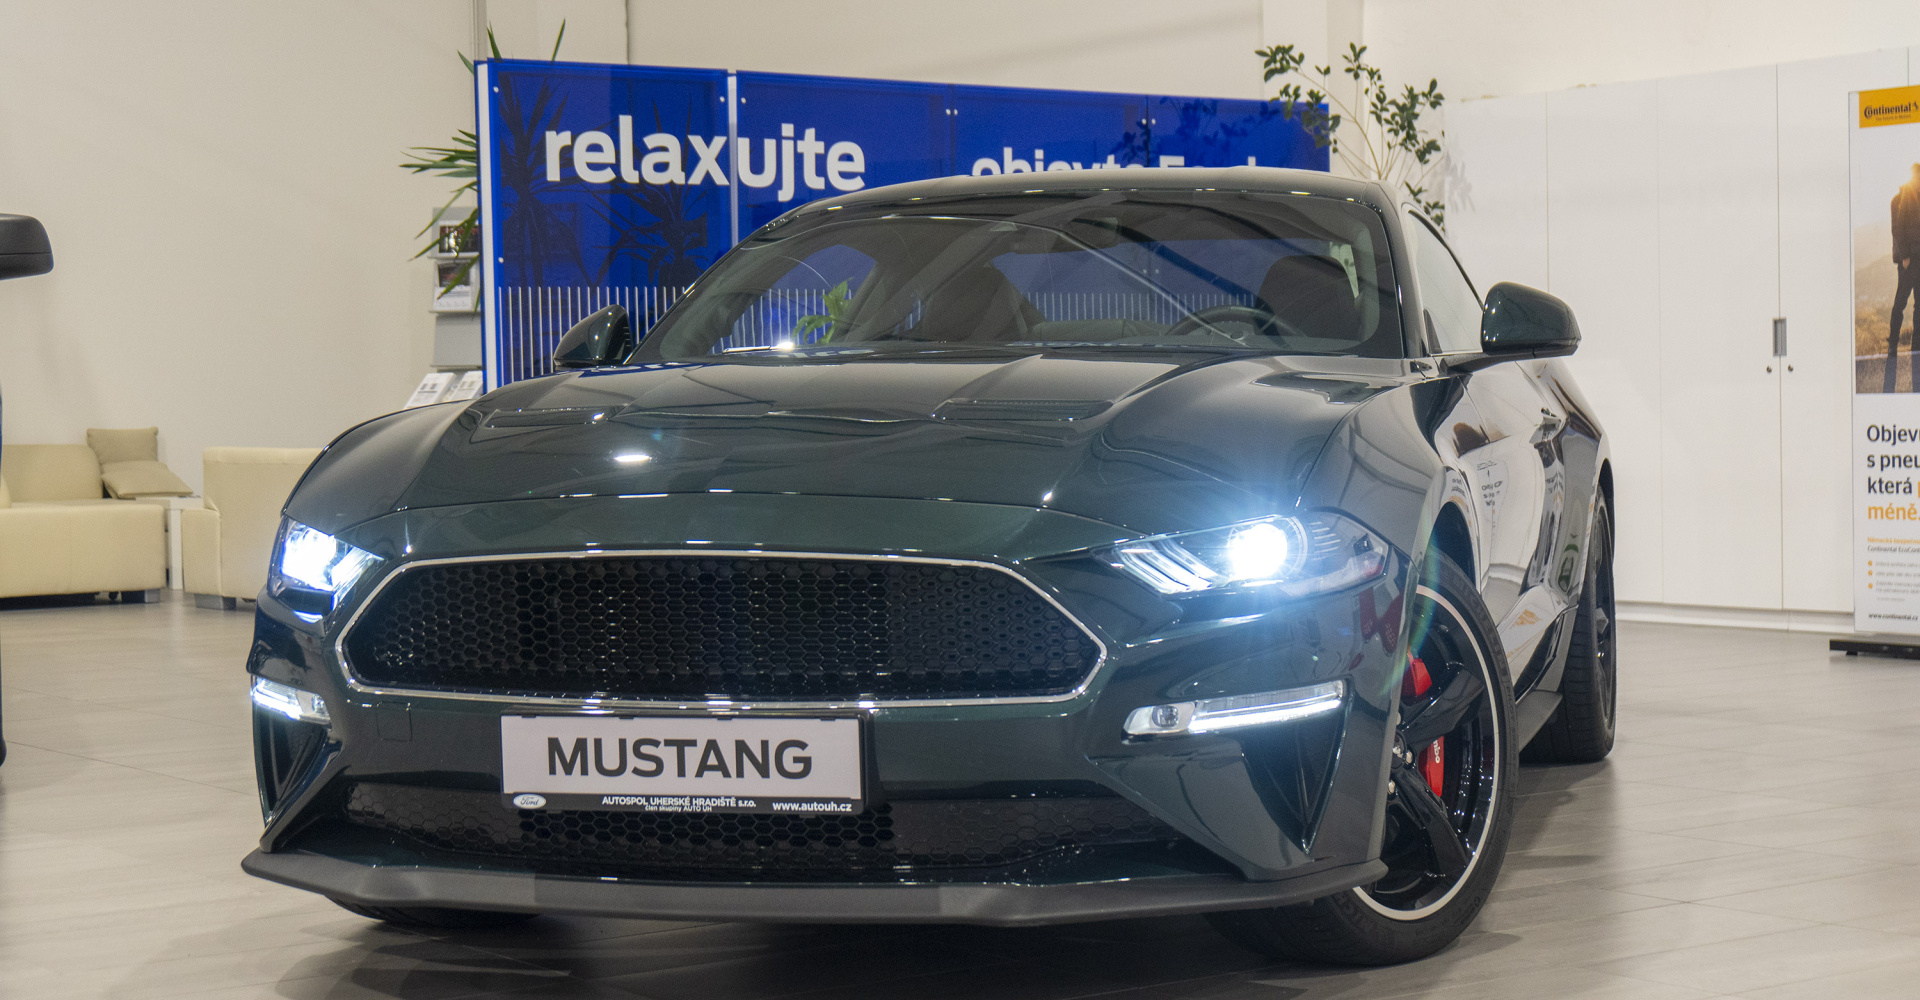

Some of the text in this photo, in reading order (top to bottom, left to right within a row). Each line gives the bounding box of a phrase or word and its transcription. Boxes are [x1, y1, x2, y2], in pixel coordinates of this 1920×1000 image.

[1864, 102, 1911, 119] Continental
[545, 115, 865, 202] relaxujte
[1867, 424, 1920, 446] Objev
[1867, 454, 1875, 468] s
[1868, 476, 1912, 494] která
[547, 736, 812, 780] MUSTANG
[520, 796, 540, 806] Ford
[602, 796, 757, 808] AUTOSPOL UHERSKÉ HRADIŠTĚ s.r.o.
[772, 801, 853, 812] www.autouh.cz
